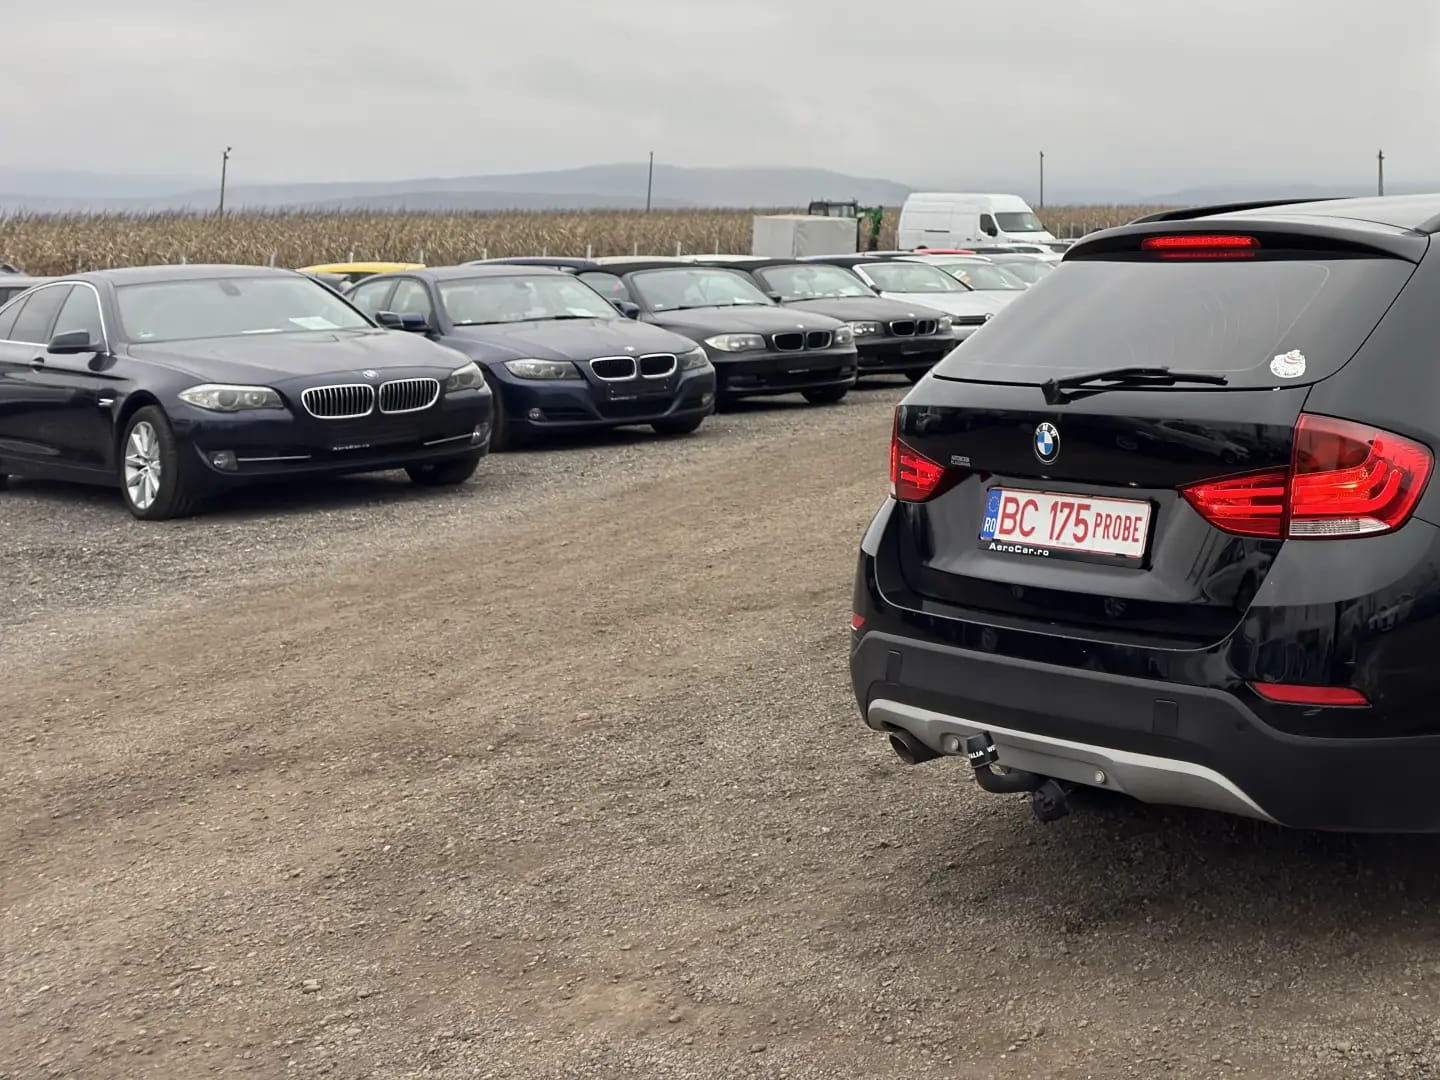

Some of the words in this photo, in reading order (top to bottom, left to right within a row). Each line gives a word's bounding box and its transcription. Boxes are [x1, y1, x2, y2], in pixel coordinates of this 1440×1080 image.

[983, 517, 996, 532] RO
[998, 496, 1039, 537] BC
[1049, 500, 1091, 543] 175
[1092, 512, 1143, 543] PROBE
[988, 542, 1049, 557] AeroCar.ro
